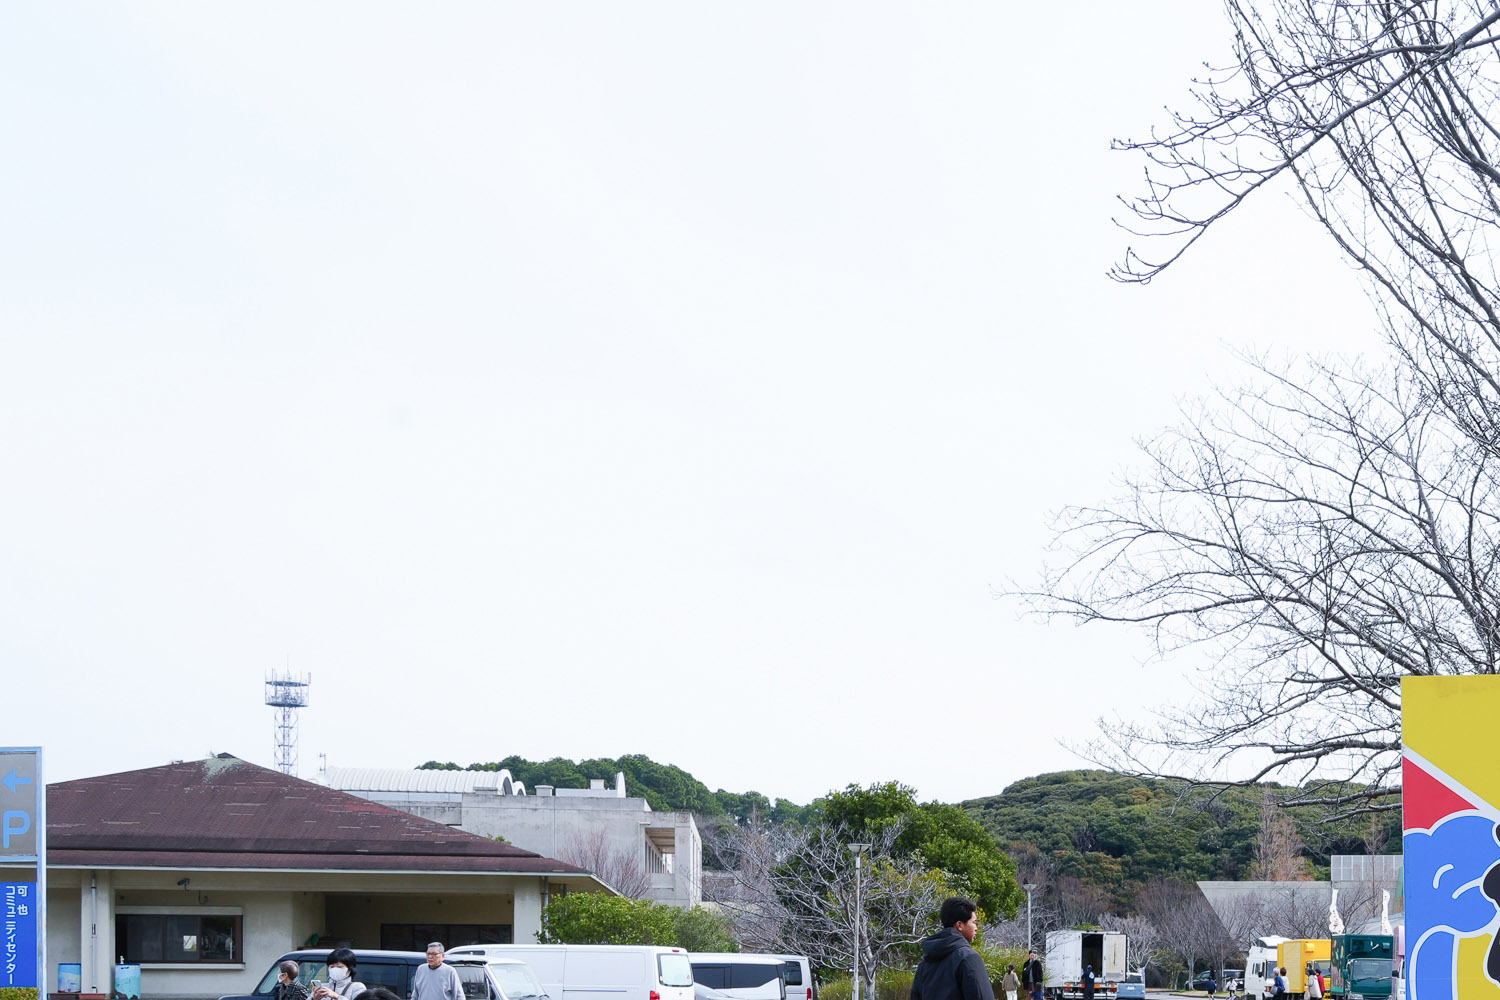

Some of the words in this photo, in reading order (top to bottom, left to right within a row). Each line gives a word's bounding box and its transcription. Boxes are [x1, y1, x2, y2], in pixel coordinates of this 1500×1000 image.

[3, 810, 31, 849] P
[17, 885, 28, 916] 可也
[6, 885, 17, 985] コミュニティセンター
